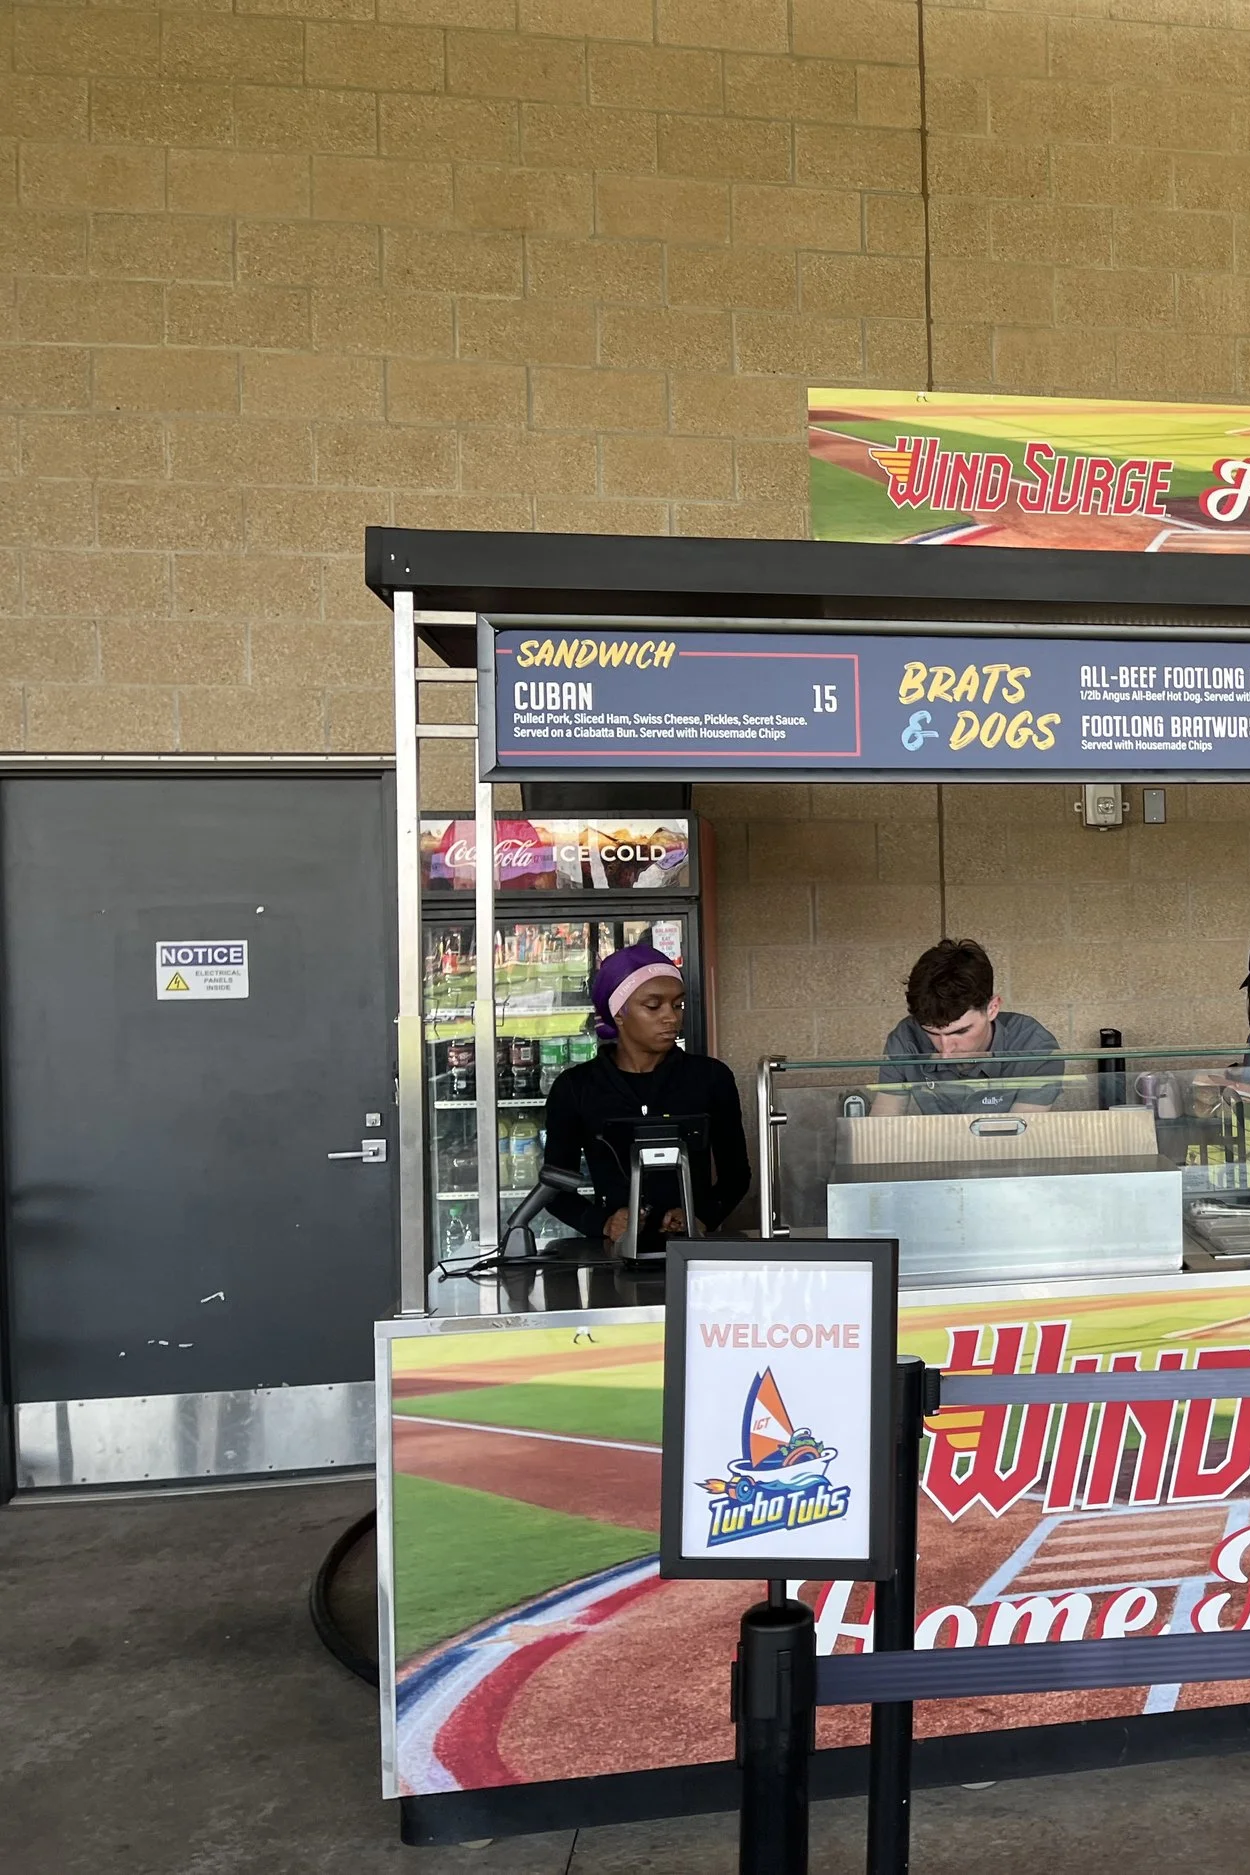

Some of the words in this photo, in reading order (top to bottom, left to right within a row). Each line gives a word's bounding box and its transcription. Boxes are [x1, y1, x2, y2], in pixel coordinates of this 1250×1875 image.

[876, 436, 1013, 511] WIND
[1017, 441, 1175, 517] SURGE
[516, 639, 676, 669] SANDWICH
[899, 661, 1031, 705] BRATS
[1081, 666, 1157, 688] ALL-BEEF
[1164, 667, 1245, 689] FOOTLONG
[514, 682, 593, 711] CUBAN
[813, 685, 838, 713] 15
[1080, 690, 1101, 701] 1/2lb
[1102, 690, 1131, 703] Angus
[1132, 690, 1166, 701] All-Beef
[1166, 691, 1182, 702] Hot
[1183, 691, 1203, 704] Dog.
[1203, 691, 1235, 702] Served
[513, 712, 544, 724] Pulled
[546, 712, 572, 725] Pork,
[574, 713, 605, 724] Sliced
[606, 714, 631, 725] Ham,
[633, 714, 662, 724] Swiss
[664, 714, 702, 726] Cheese,
[704, 714, 741, 726] Pickles,
[742, 715, 774, 725] Secret
[775, 715, 808, 726] Sauce.
[901, 710, 939, 751] &
[949, 710, 1061, 750] DOGS
[1081, 716, 1164, 738] FOOTLONG
[513, 726, 549, 738] Served
[550, 728, 564, 738] on
[565, 729, 573, 738] a
[573, 727, 614, 738] Ciabatta
[616, 727, 639, 738] Bun.
[640, 727, 675, 738] Served
[676, 727, 698, 738] with
[699, 728, 757, 739] Housemade
[758, 728, 787, 741] Chips
[1081, 739, 1113, 750] Served
[1114, 740, 1134, 750] with
[1135, 740, 1187, 751] Housemade
[1187, 740, 1213, 753] Chips
[445, 839, 537, 867] CocCola
[553, 845, 591, 862] ICE
[600, 845, 666, 862] COLD
[161, 947, 242, 964] NOTICE
[699, 1323, 860, 1349] WELCOME
[753, 1416, 771, 1431] ICT
[711, 1491, 785, 1536] Turbo
[787, 1485, 848, 1527] Tubs
